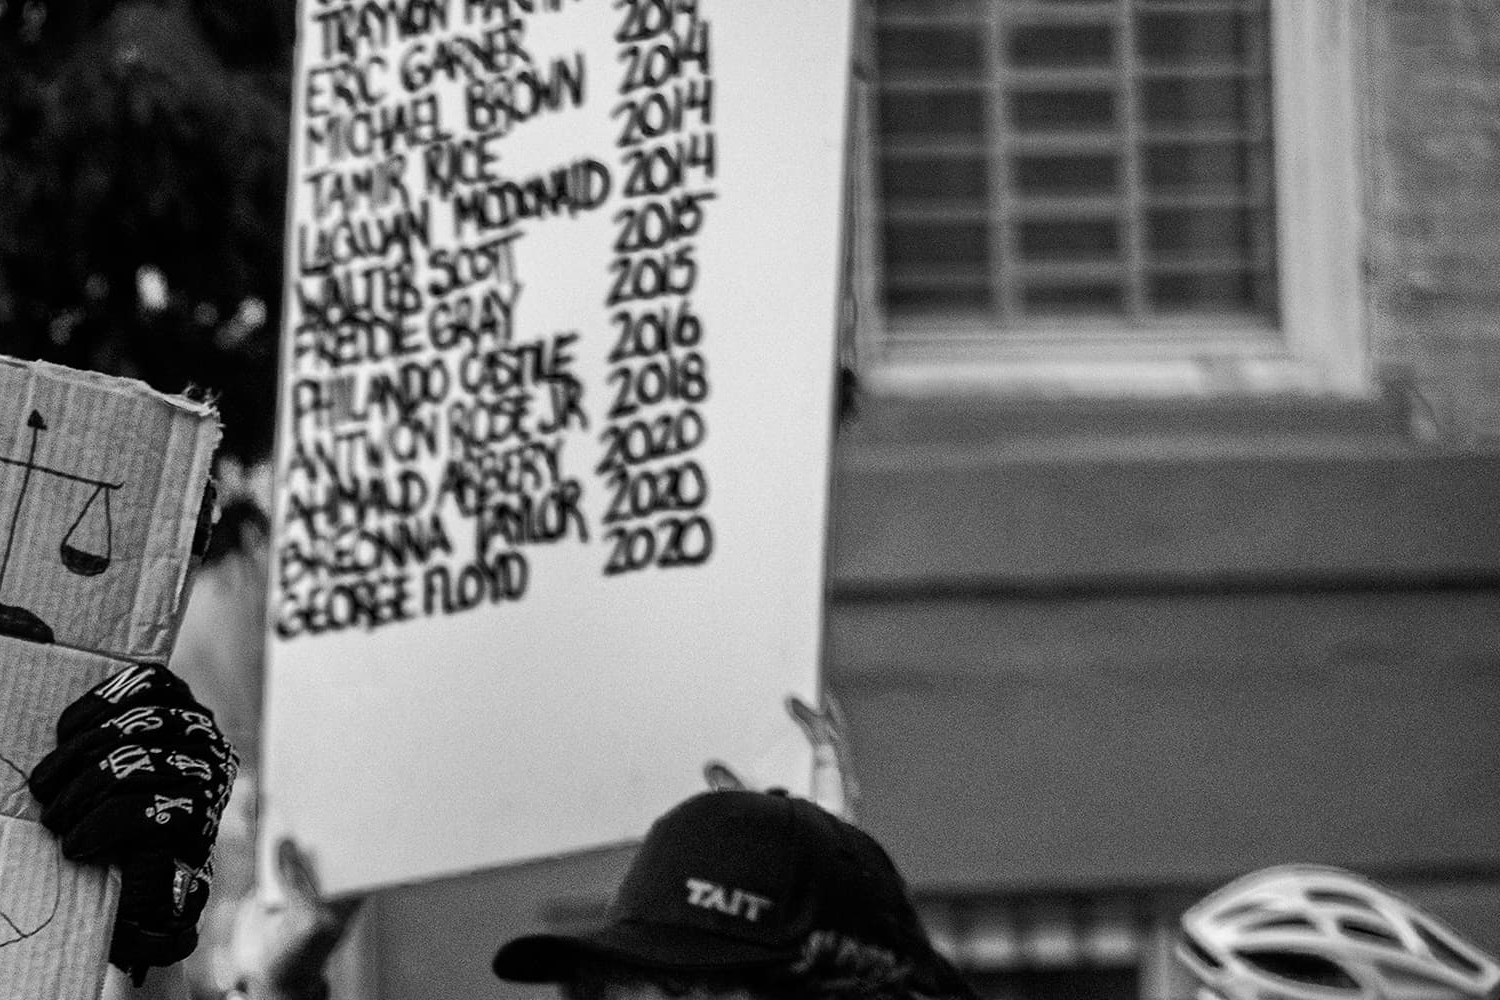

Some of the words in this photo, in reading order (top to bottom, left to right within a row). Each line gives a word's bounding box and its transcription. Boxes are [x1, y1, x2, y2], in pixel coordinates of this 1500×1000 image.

[465, 50, 587, 133] BROWN
[421, 132, 510, 203] RICE
[610, 78, 714, 149] 2014
[622, 131, 717, 199] 2014
[428, 278, 523, 352] GRAY
[605, 243, 698, 306] 2015
[605, 299, 702, 364] 2016
[607, 350, 710, 418] 2018
[595, 405, 706, 477] 2020
[600, 460, 708, 525] 2020
[601, 515, 714, 577] 2020
